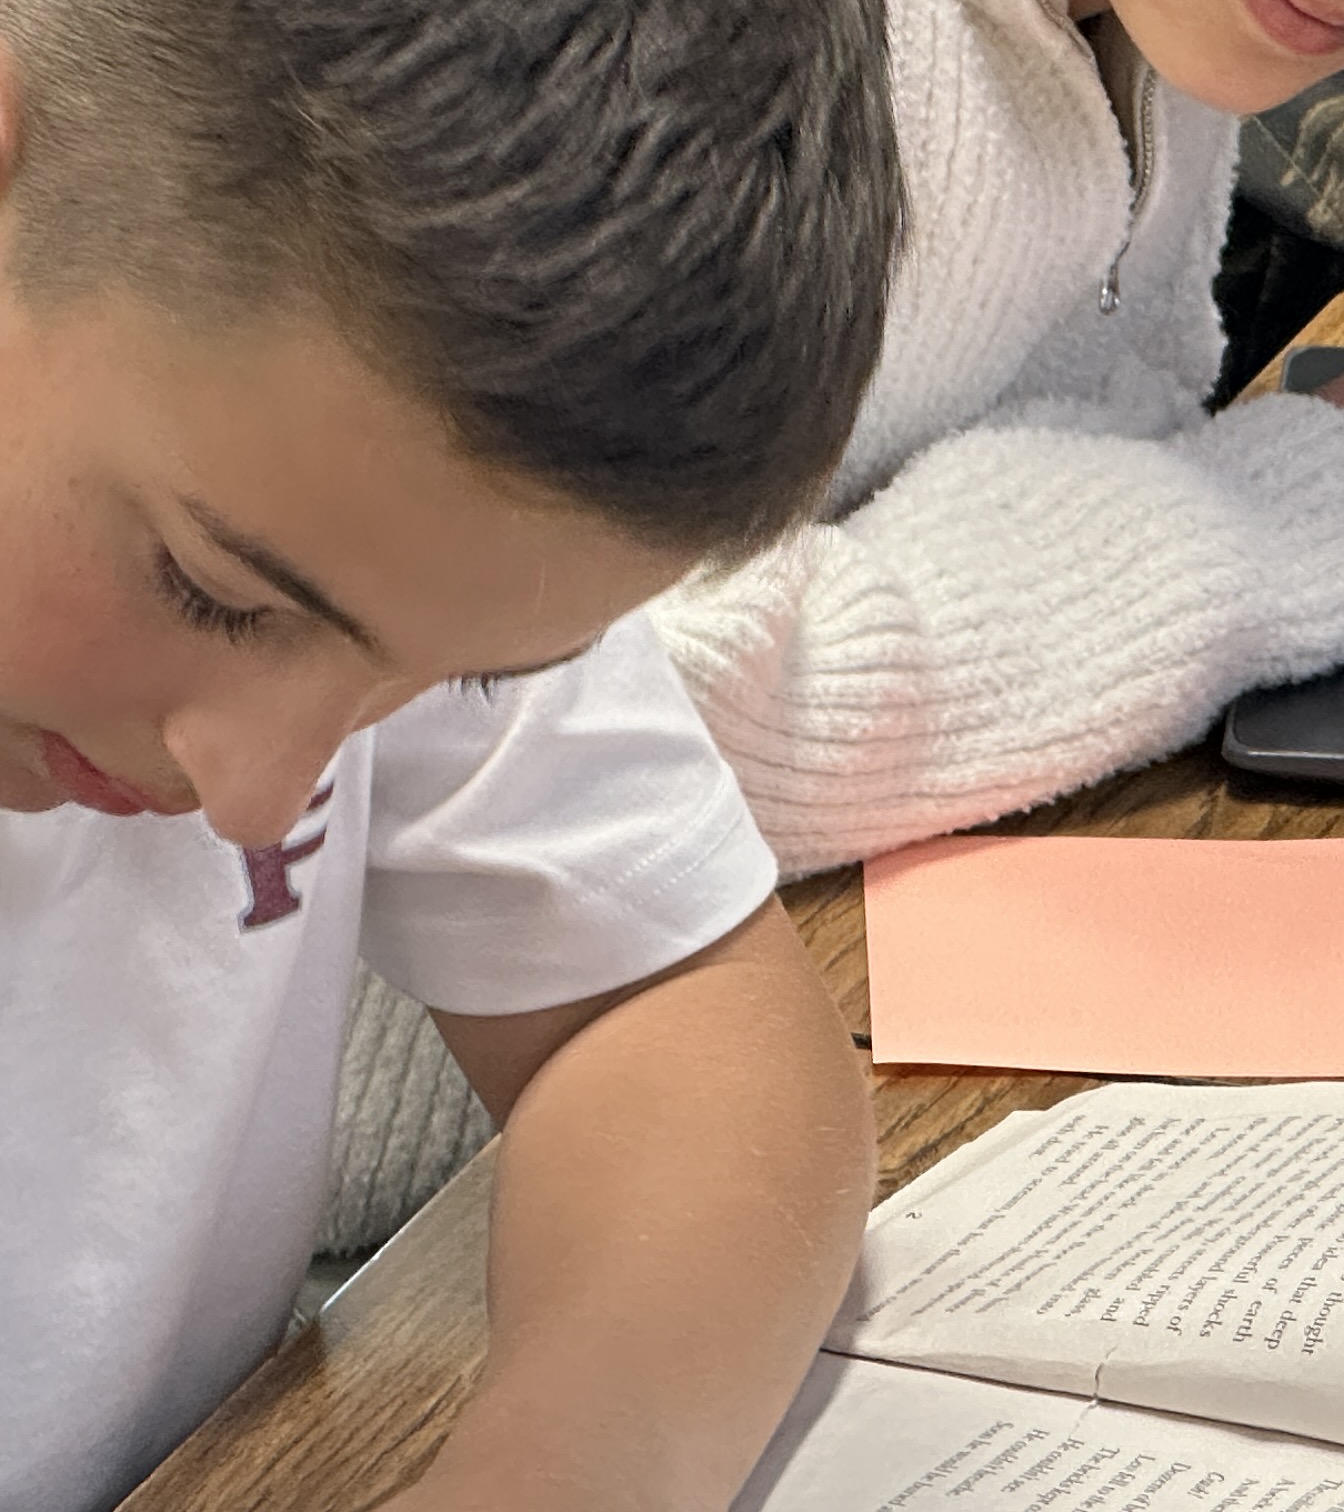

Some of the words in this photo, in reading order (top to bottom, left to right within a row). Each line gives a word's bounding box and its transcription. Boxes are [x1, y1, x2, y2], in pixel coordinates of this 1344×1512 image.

[1232, 1235, 1290, 1283] Powerful
[1278, 1238, 1314, 1269] pieces
[1311, 1247, 1343, 1270] idea
[1178, 1276, 1218, 1310] layers
[1262, 1278, 1278, 1294] of
[1289, 1277, 1317, 1303] that
[1100, 1297, 1124, 1322] and
[1133, 1285, 1170, 1327] ripped
[1200, 1289, 1238, 1337] shocks
[1233, 1301, 1262, 1342] earth
[1166, 1316, 1182, 1336] of
[1264, 1311, 1297, 1349] deep
[1301, 1292, 1344, 1355] thought
